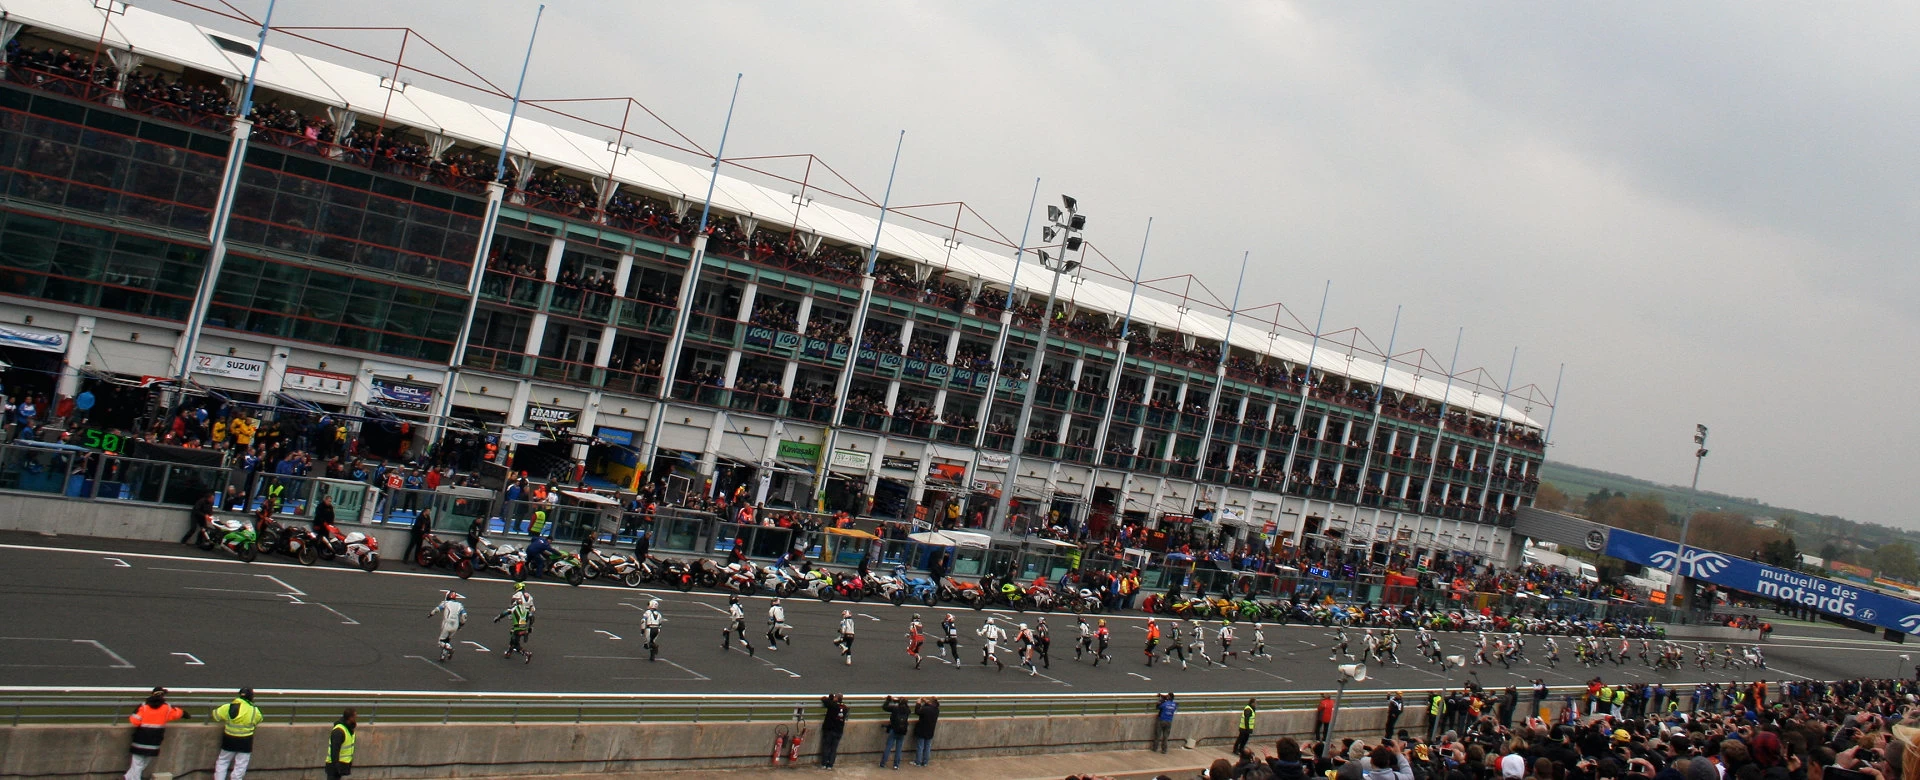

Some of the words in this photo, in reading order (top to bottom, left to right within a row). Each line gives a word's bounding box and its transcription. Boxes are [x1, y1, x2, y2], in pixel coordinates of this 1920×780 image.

[199, 355, 212, 367] 72
[226, 360, 260, 372] SUZUKI
[932, 364, 949, 375] IGO
[955, 369, 972, 380] IGO
[530, 407, 570, 420] FRANCE
[781, 444, 817, 456] Kawasaki
[1760, 568, 1827, 592] mutuelle
[1831, 585, 1858, 600] des
[1756, 579, 1855, 617] motards
[1859, 609, 1874, 620] .fr
